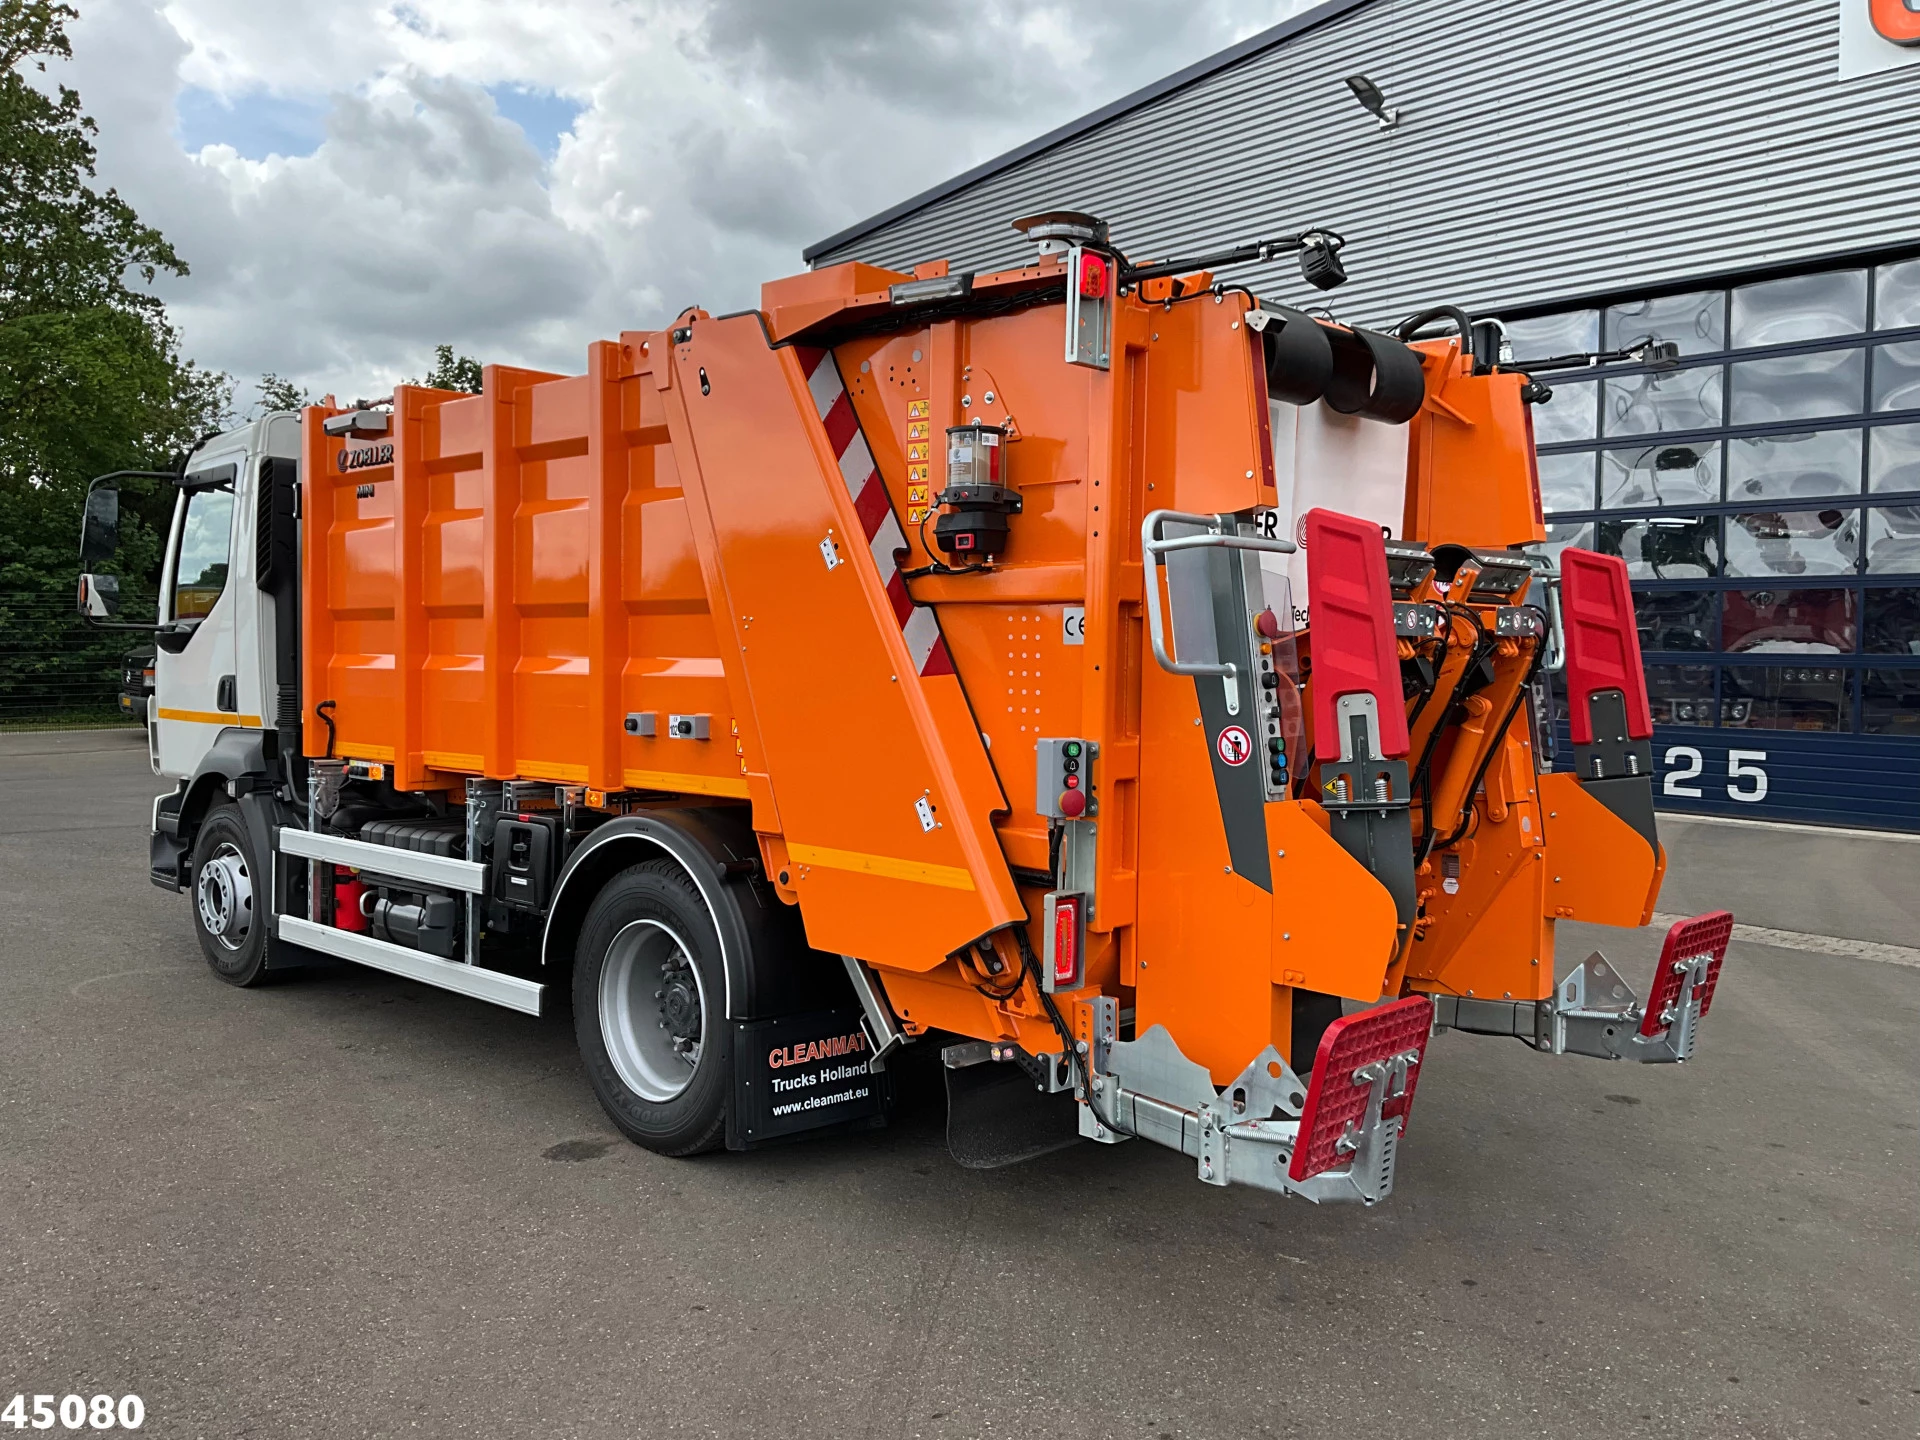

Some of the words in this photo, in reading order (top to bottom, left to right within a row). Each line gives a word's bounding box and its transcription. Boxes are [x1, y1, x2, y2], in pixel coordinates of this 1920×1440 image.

[349, 444, 394, 469] ZOELLER
[356, 484, 375, 499] MINI
[768, 1031, 866, 1069] CLEANMAT
[771, 1073, 817, 1093] Trucks
[820, 1060, 868, 1083] Holland
[772, 1086, 869, 1116] www.cleanmat.eu
